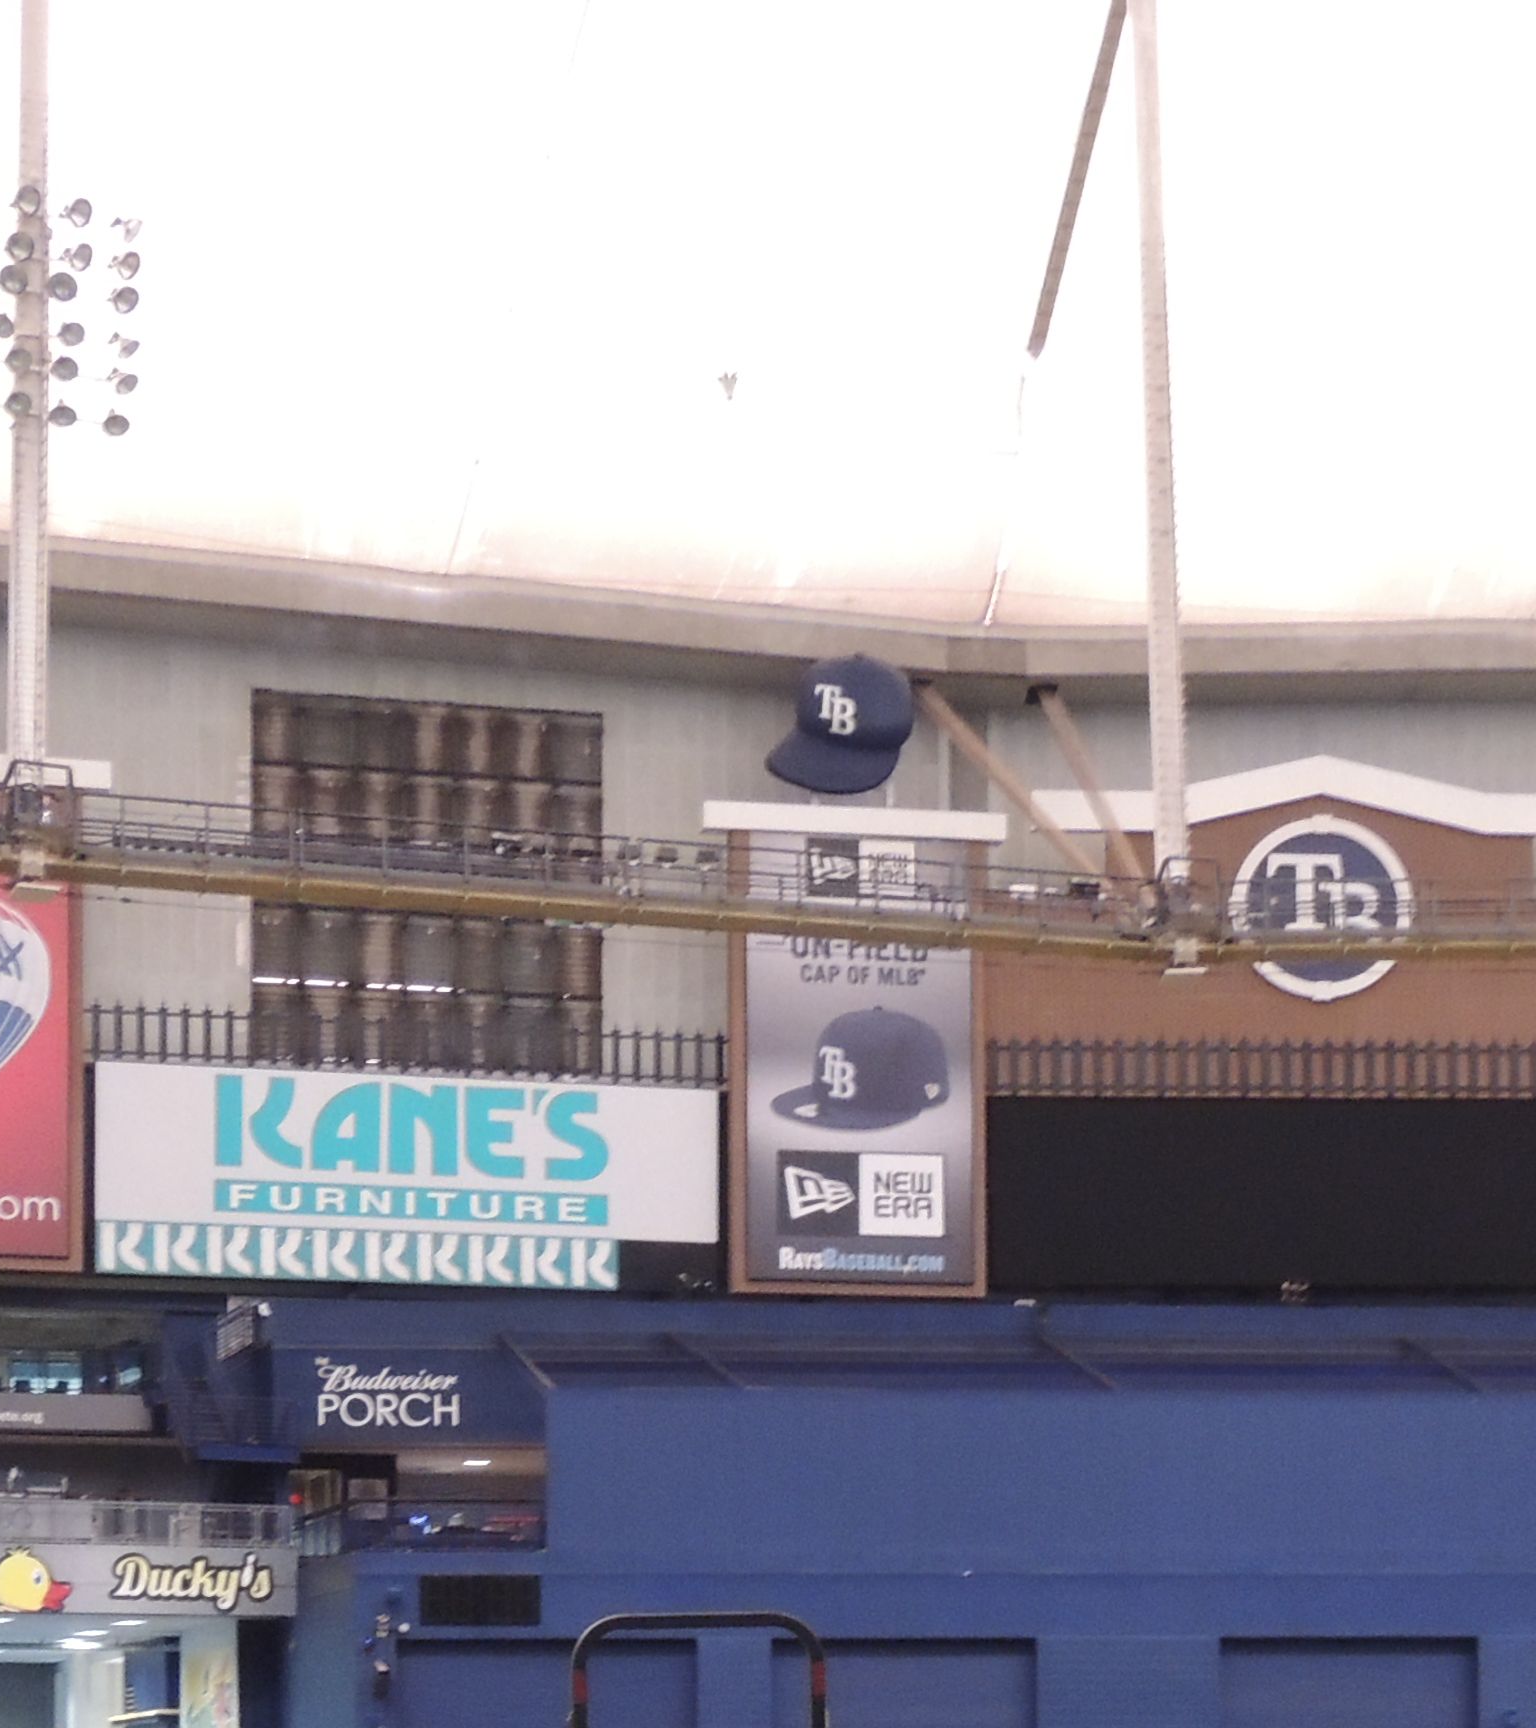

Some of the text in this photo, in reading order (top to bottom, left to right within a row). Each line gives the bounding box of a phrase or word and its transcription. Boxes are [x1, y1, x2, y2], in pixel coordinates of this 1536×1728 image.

[814, 683, 857, 735] TB
[800, 963, 840, 984] CAP
[847, 965, 869, 985] OF
[818, 1045, 857, 1099] TB
[213, 1073, 610, 1182] KANE'S
[873, 1171, 933, 1195] NEW
[228, 1184, 588, 1224] FURNITURE
[873, 1195, 933, 1219] ERA
[317, 1364, 460, 1392] Budweiser
[317, 1392, 461, 1427] PORCH
[112, 1554, 272, 1610] Ducky's
